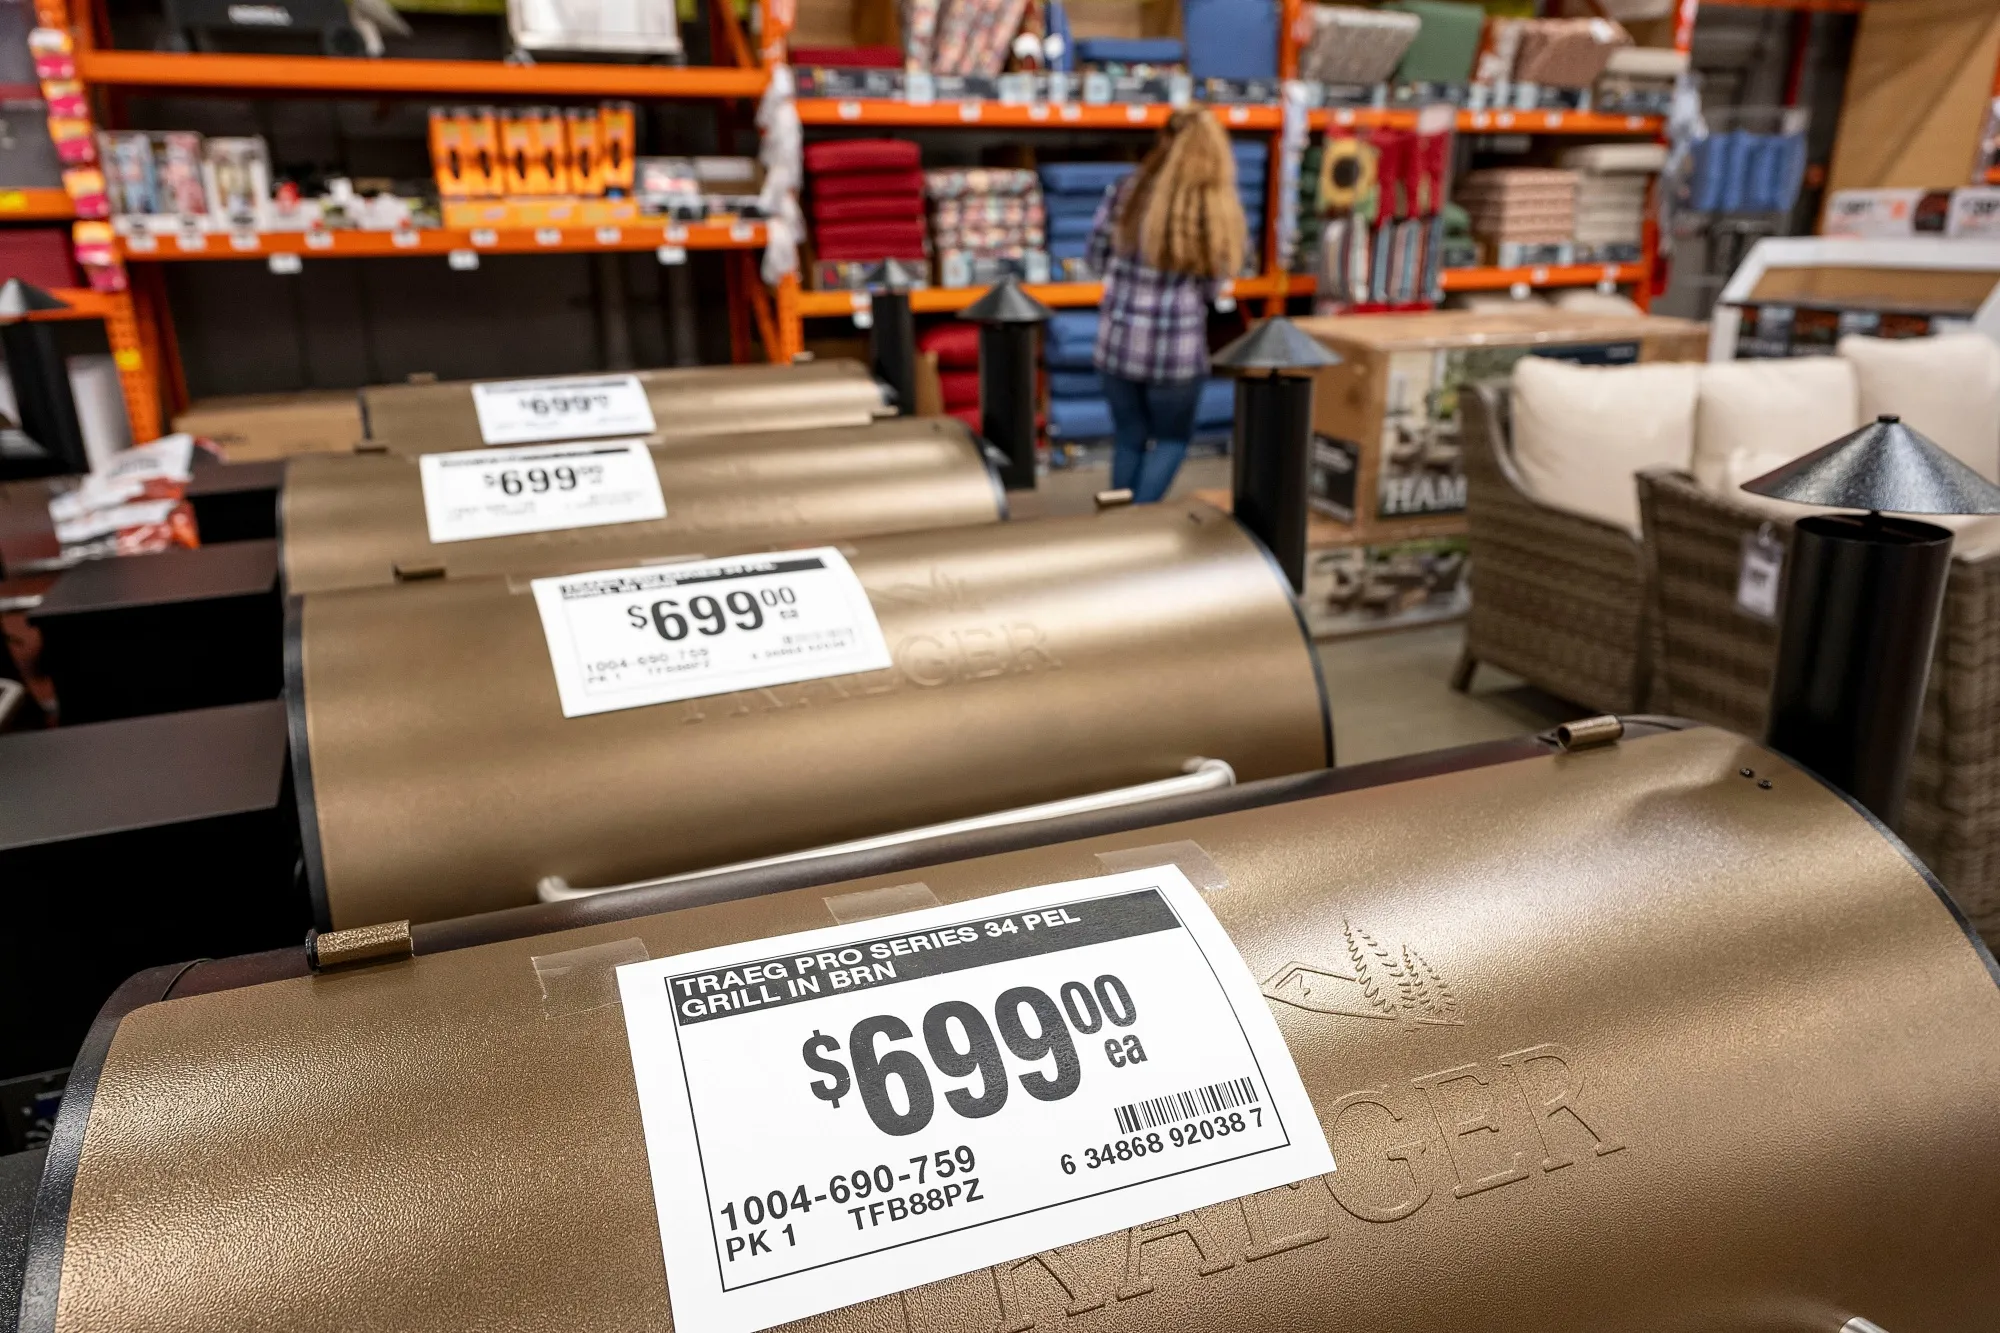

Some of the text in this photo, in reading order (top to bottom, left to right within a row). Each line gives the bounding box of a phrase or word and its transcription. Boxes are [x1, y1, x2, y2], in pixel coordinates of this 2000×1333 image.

[627, 590, 765, 641] $699
[675, 908, 1081, 997] TRAEG PRO SERIES 34 PEL
[681, 960, 898, 1018] GRILL IN BRN
[802, 986, 1081, 1137] $699
[1103, 1033, 1149, 1069] ea
[1060, 1107, 1263, 1175] 6 34868 92038 7
[720, 1144, 976, 1231] 1004-690-759
[725, 1177, 984, 1262] PK 1 TFB88PZ
